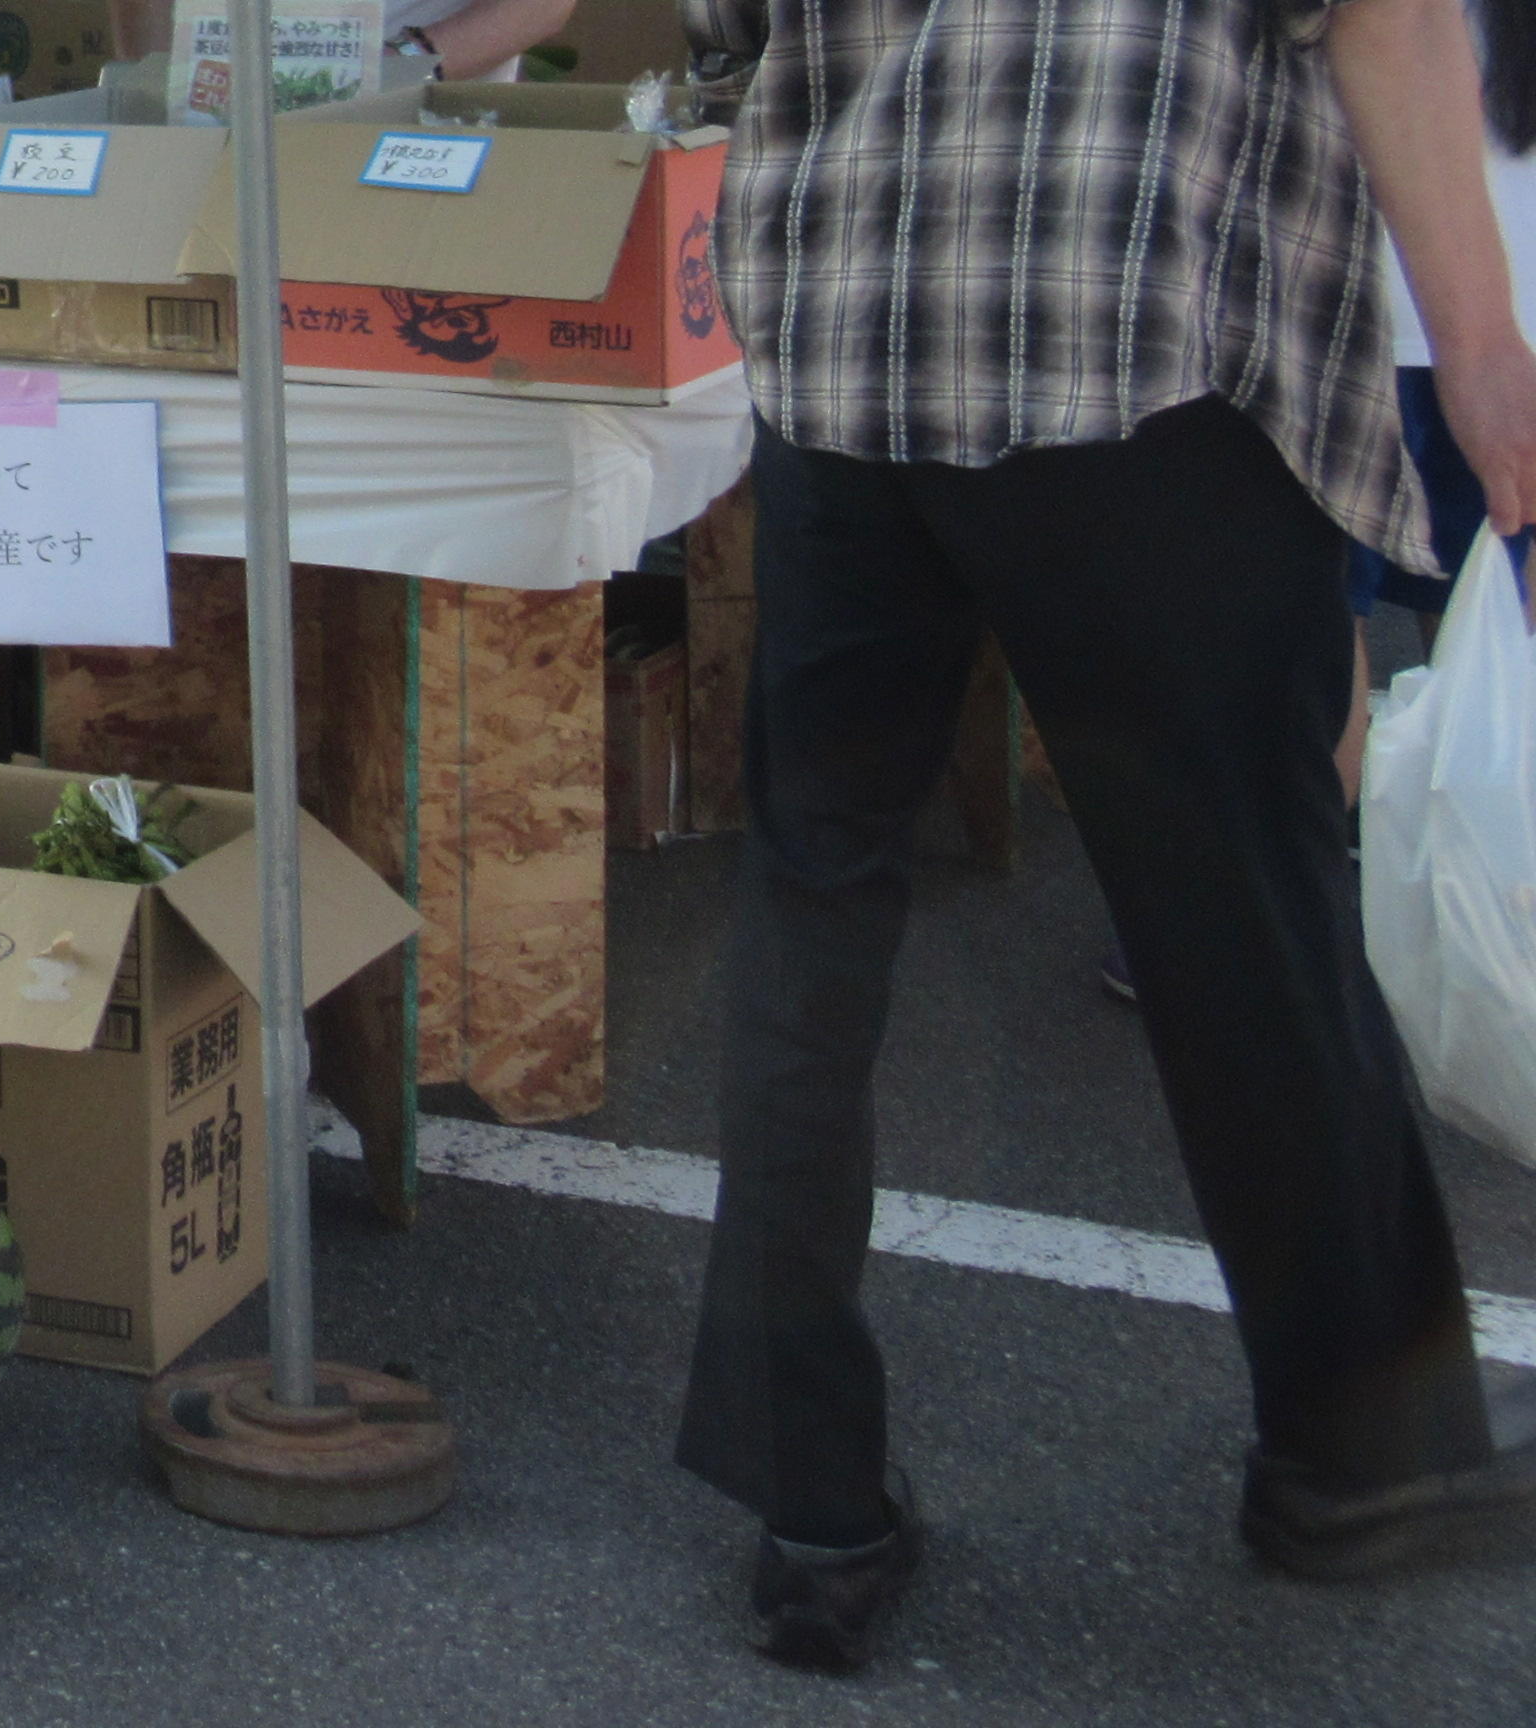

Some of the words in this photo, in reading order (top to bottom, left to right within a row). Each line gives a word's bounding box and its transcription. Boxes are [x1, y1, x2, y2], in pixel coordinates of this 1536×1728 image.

[279, 304, 374, 335] Aさがえ
[549, 319, 633, 352] 西村山
[170, 1005, 240, 1101] 業務用
[161, 1115, 216, 1208] 角瓶
[169, 1207, 206, 1276] 5L
